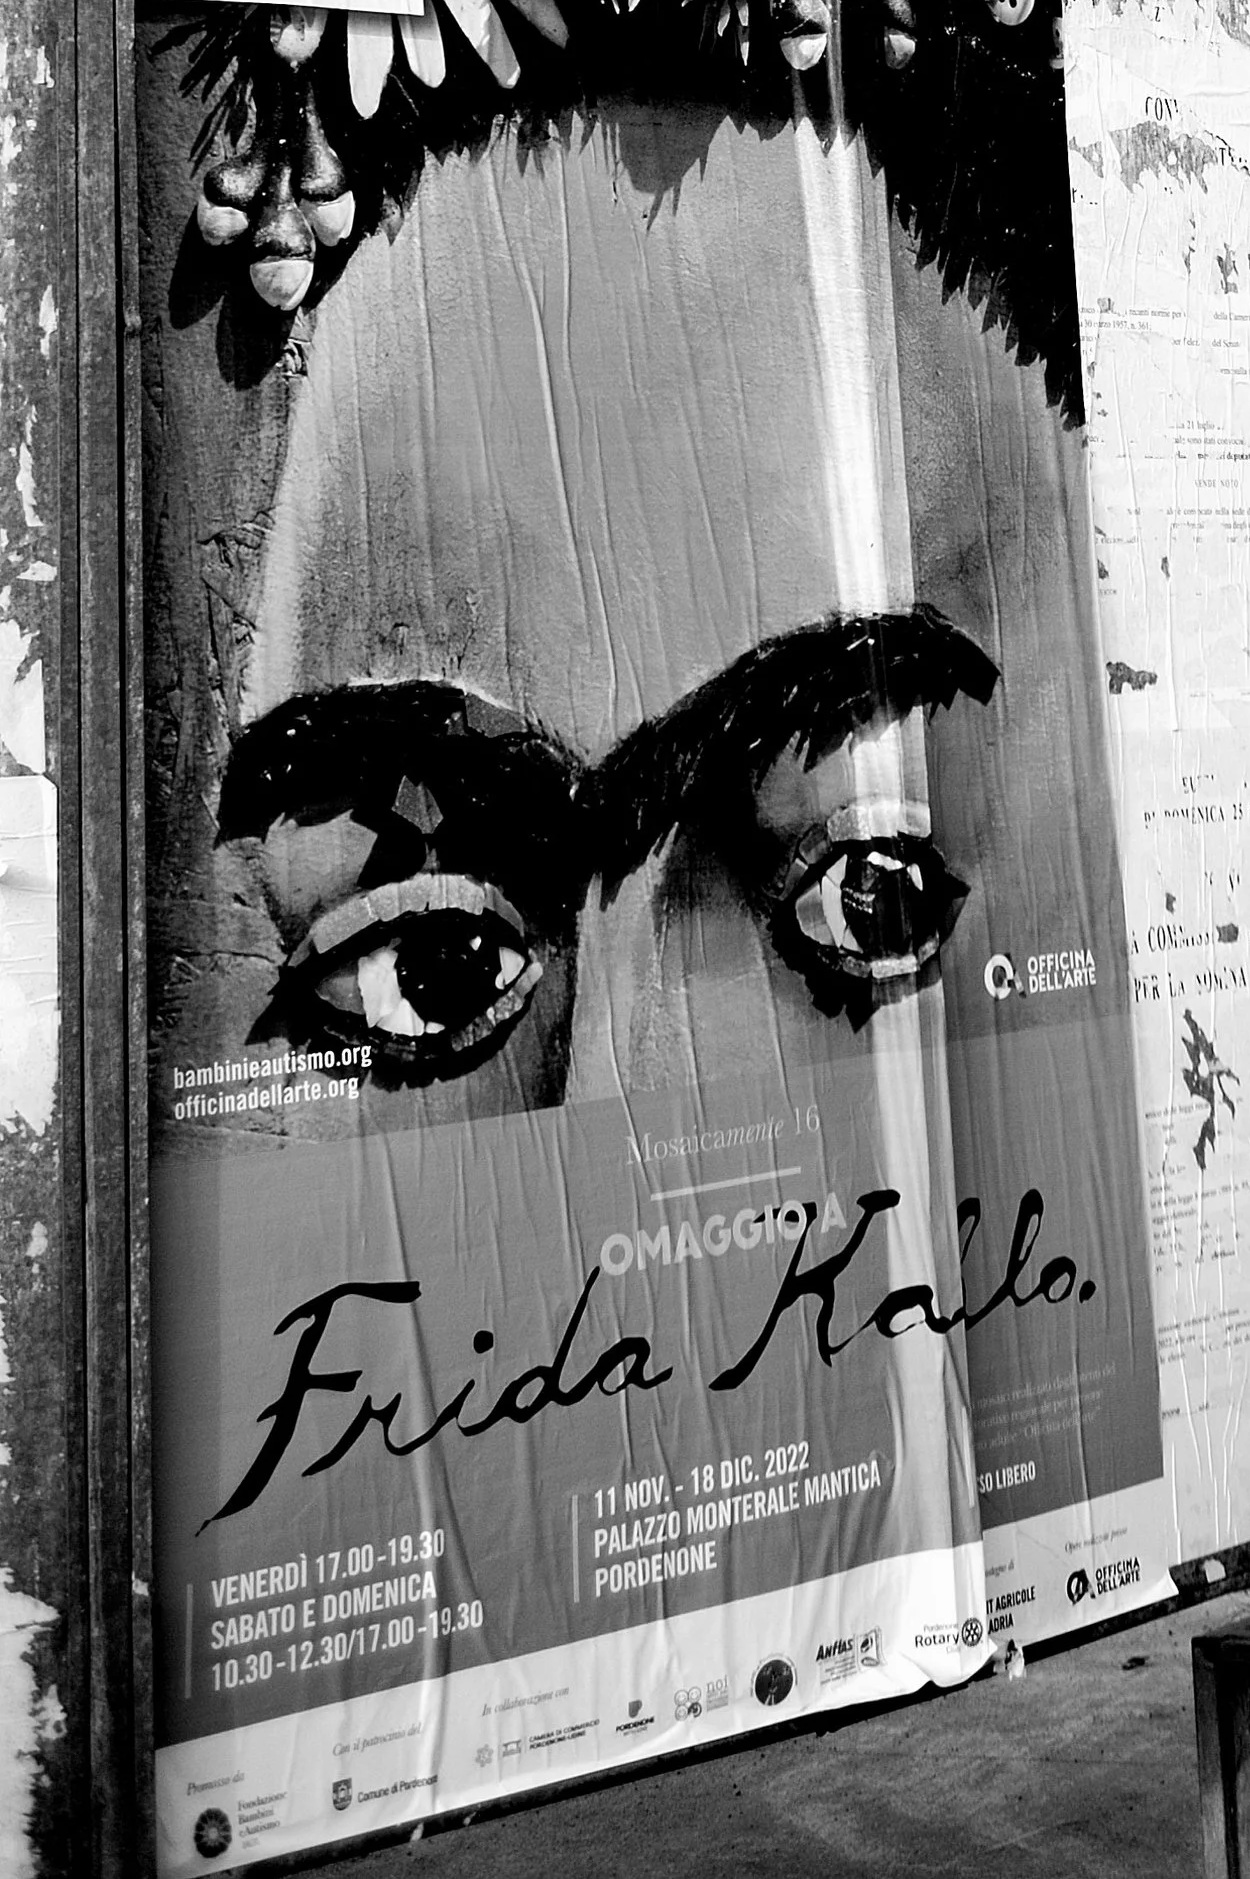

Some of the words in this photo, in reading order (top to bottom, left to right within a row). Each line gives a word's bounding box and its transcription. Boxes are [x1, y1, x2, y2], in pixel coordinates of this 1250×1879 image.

[1027, 948, 1096, 975] OFFICINA
[1028, 966, 1097, 994] DELL'ARTE
[173, 1042, 372, 1090] bambinieautismo.org
[174, 1074, 360, 1121] officinadellarte.org
[625, 1115, 785, 1165] Mosaicamente
[794, 1104, 821, 1135] 16
[600, 1200, 807, 1276] OMAGGIO
[820, 1191, 847, 1233] A
[194, 1265, 674, 1536] Frida
[594, 1488, 617, 1519] 11
[625, 1478, 670, 1511] NOV.
[690, 1465, 714, 1496] 18
[720, 1455, 760, 1490] DIC.
[765, 1442, 810, 1479] 2022
[996, 1460, 1036, 1490] LIBERO
[594, 1510, 681, 1558] PALAZZO
[687, 1482, 800, 1535] MONTERALE
[804, 1459, 882, 1507] MANTICA
[211, 1553, 308, 1608] VENERDÌ
[595, 1543, 717, 1597] PORDENONE
[1095, 1556, 1140, 1581] OFFICINA
[1097, 1570, 1140, 1595] DELL'ARTE
[211, 1604, 295, 1650] SABATO
[303, 1599, 316, 1628] E
[323, 1571, 438, 1625] DOMENICA
[995, 1585, 1035, 1613] AGRICOLE
[915, 1632, 959, 1648] Rotary
[357, 1787, 390, 1803] Comune
